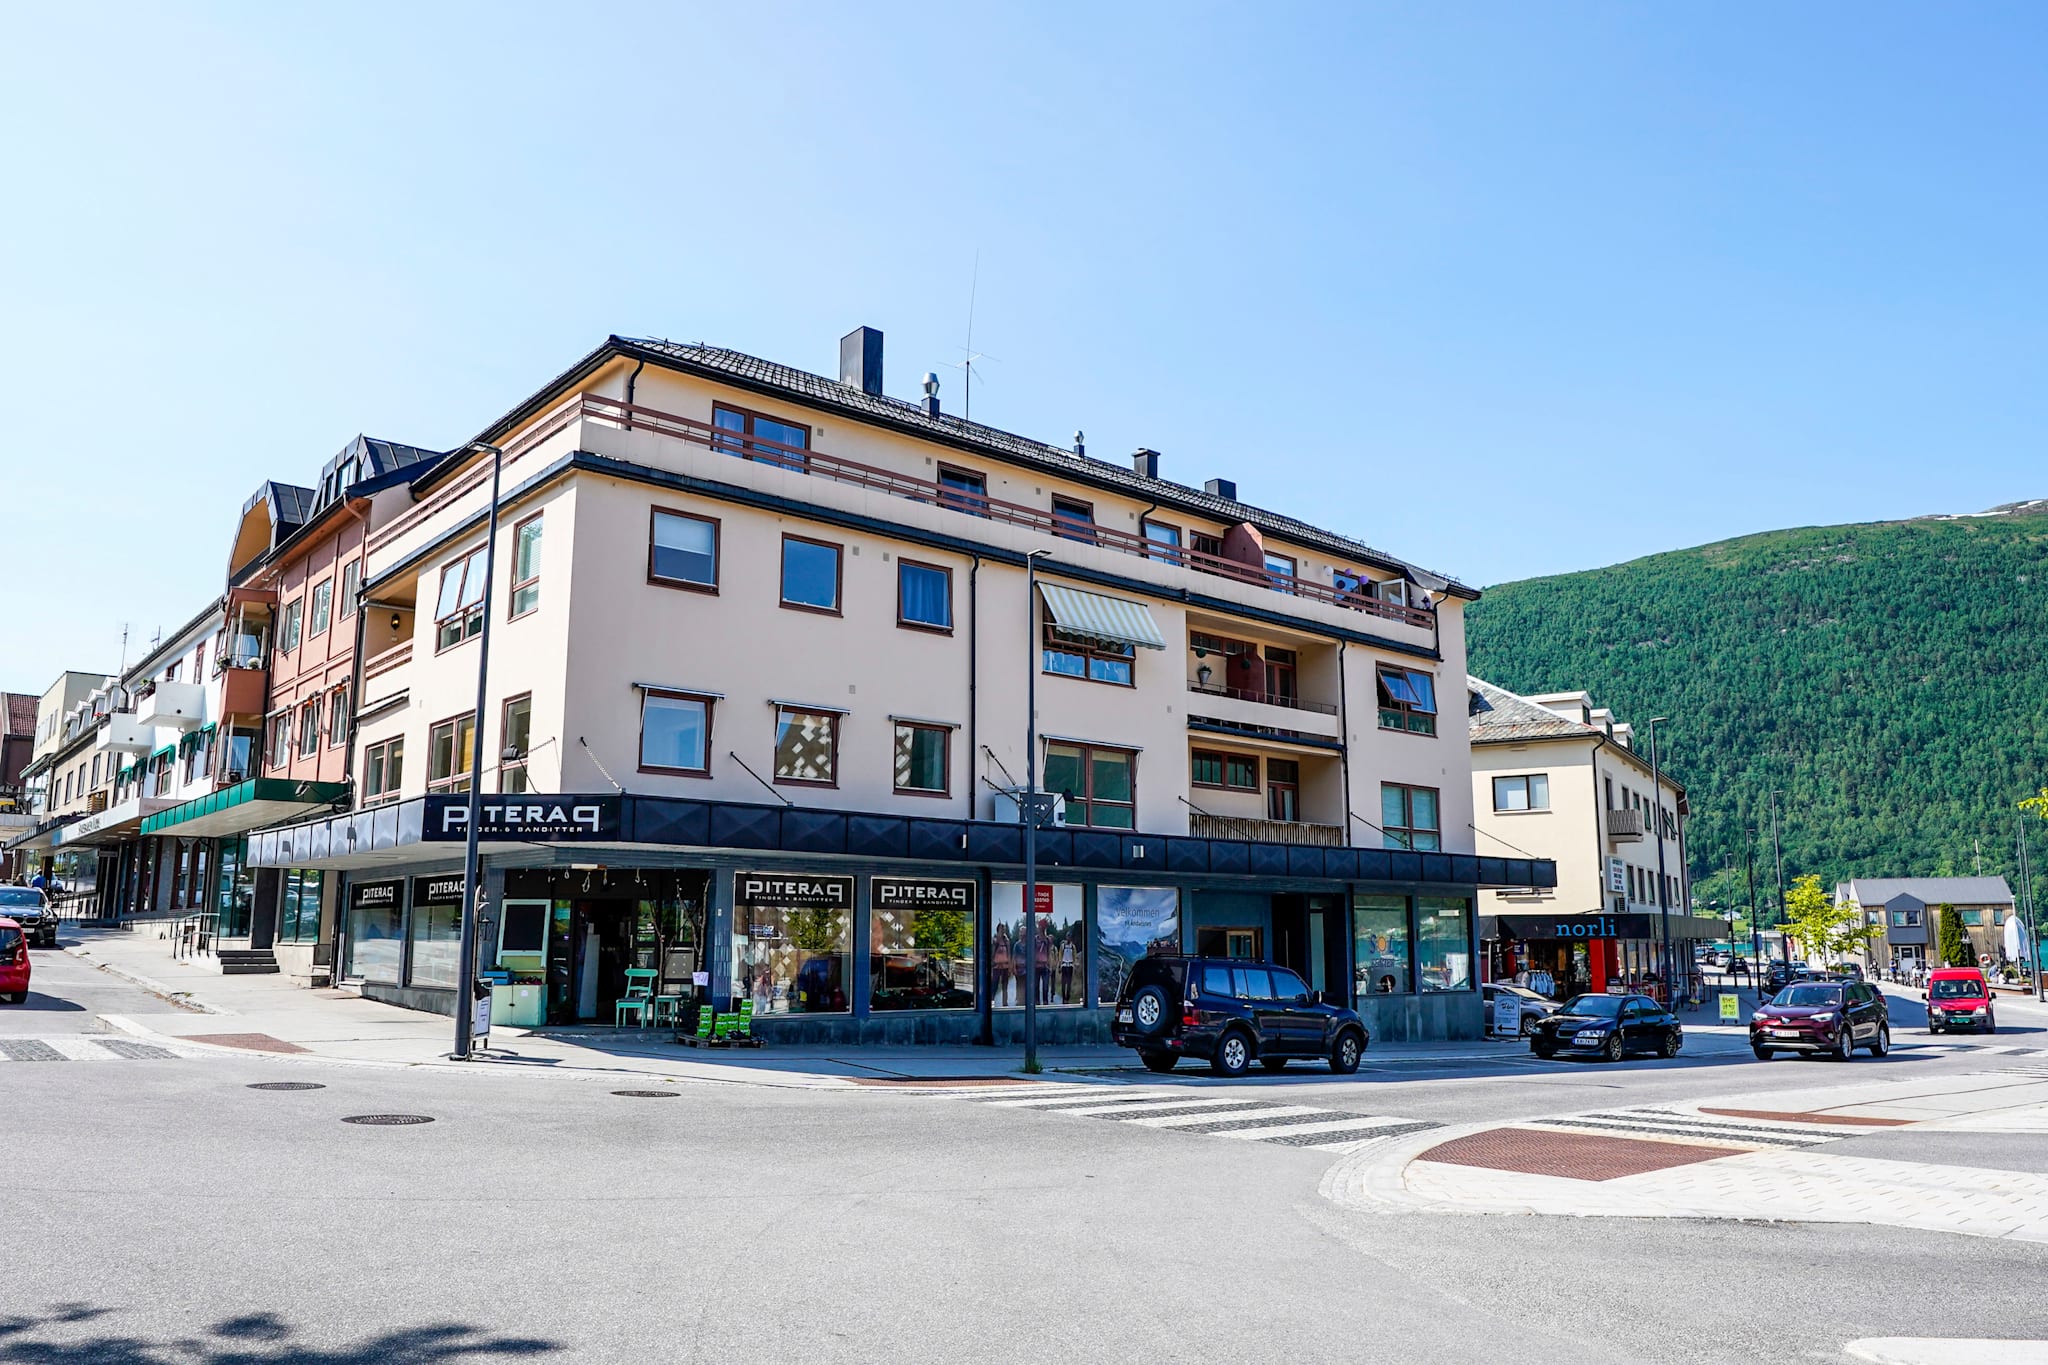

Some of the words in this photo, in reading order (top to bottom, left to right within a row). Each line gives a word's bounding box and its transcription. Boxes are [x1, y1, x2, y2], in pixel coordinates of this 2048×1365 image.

[442, 805, 601, 833] PTERAQ
[362, 886, 394, 905] PITERAQ
[745, 880, 843, 903] PITERAQ
[880, 885, 967, 906] PITERAQ
[1116, 906, 1160, 918] Velkommen
[1556, 917, 1617, 937] norli
